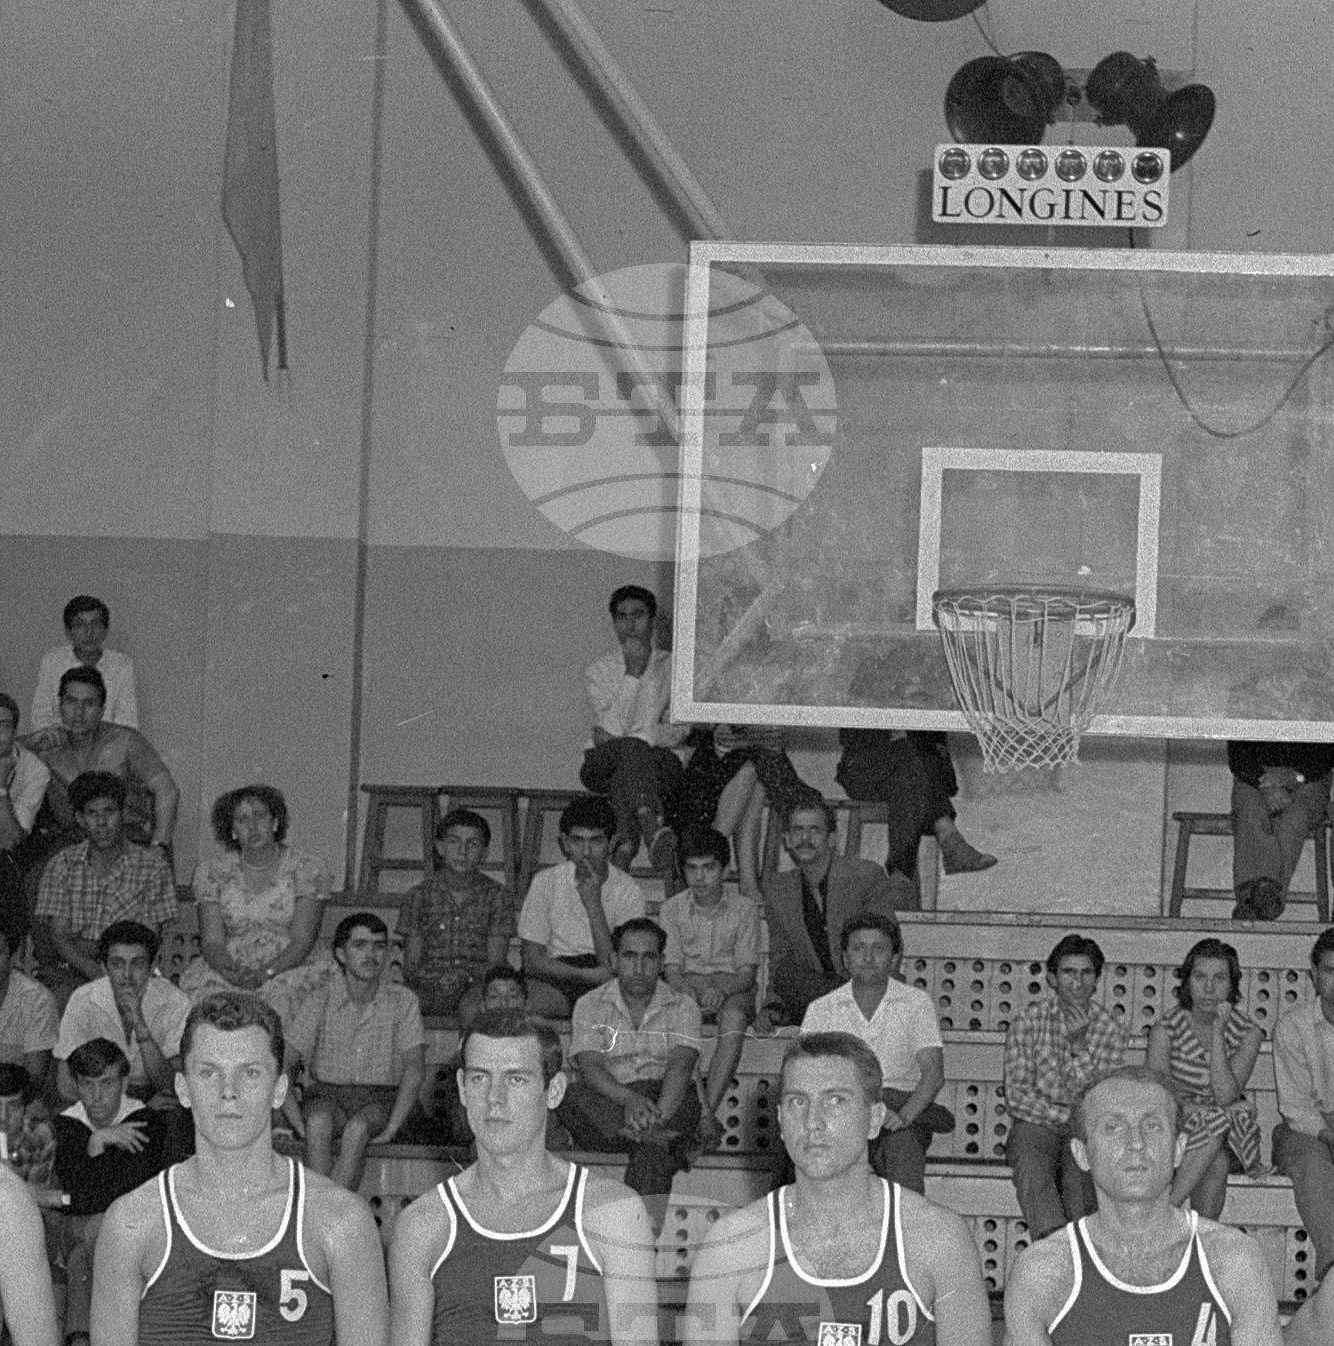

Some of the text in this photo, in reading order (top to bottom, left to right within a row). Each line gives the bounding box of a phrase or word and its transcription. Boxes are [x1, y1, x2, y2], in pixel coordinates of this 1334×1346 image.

[938, 186, 1164, 222] LONGINES
[279, 1269, 310, 1321] 5
[550, 1245, 578, 1301] 7
[867, 1288, 916, 1345] 10
